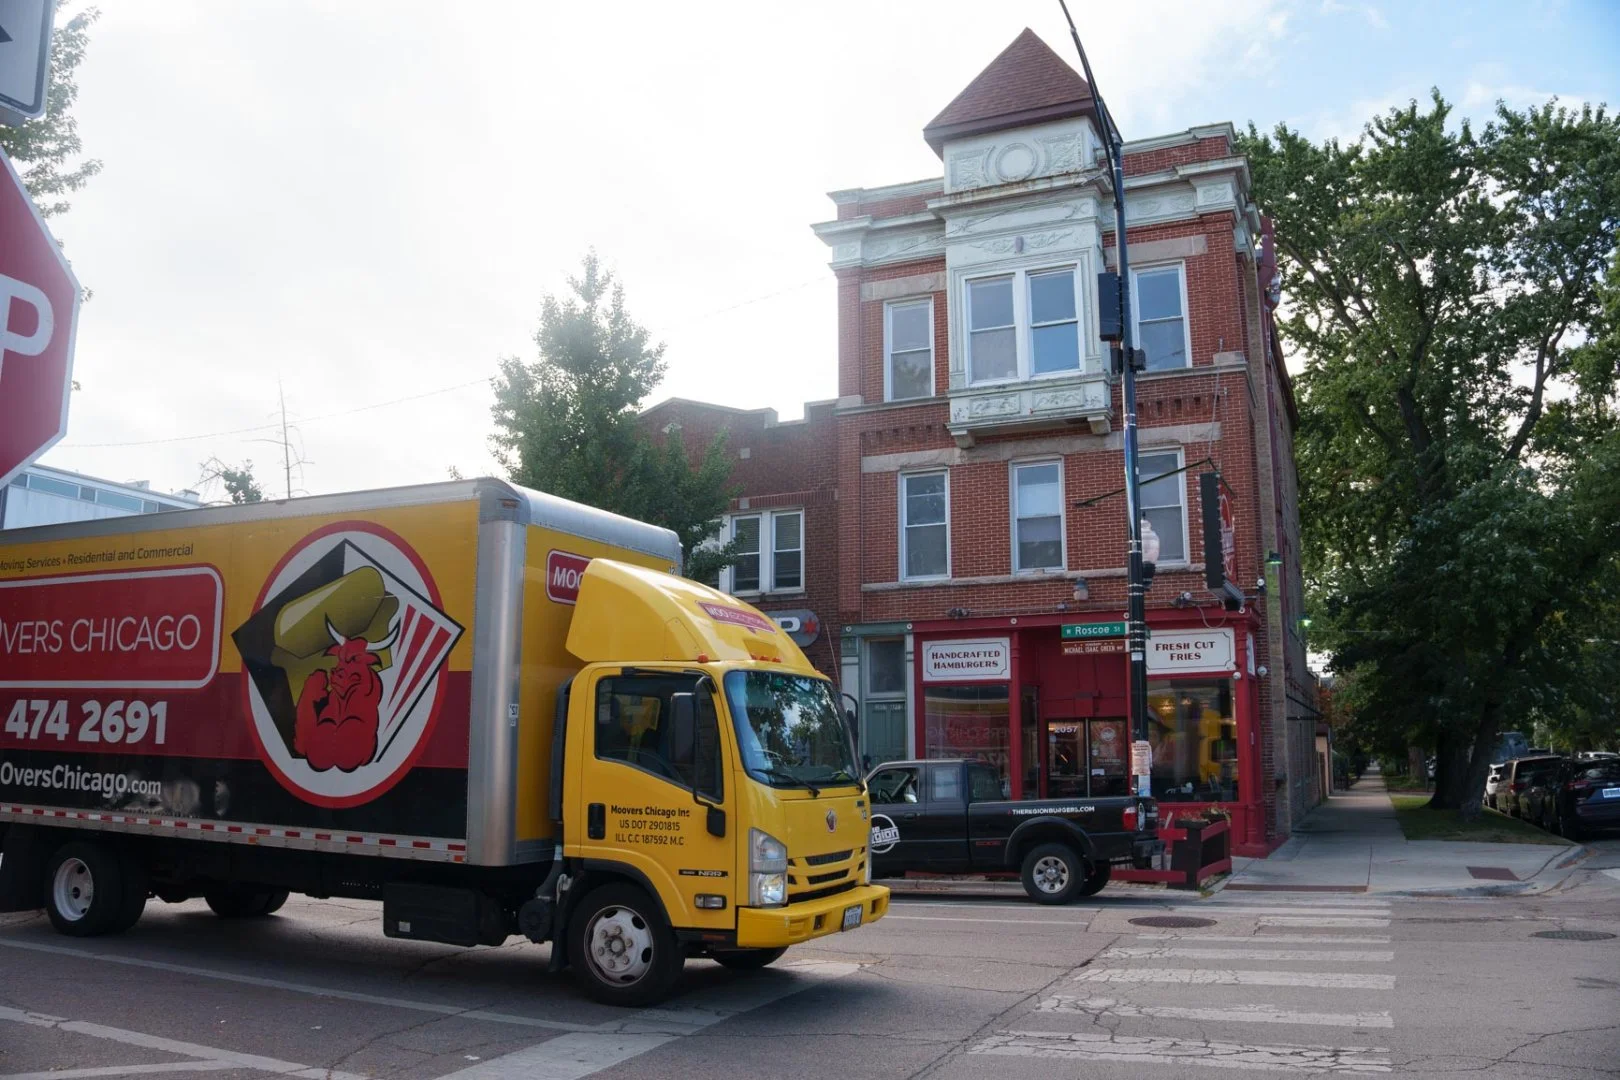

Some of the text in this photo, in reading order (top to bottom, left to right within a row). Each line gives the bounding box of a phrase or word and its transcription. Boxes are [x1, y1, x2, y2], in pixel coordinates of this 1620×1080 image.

[26, 558, 61, 568] Services
[67, 551, 115, 565] Residential
[118, 549, 135, 561] and
[137, 544, 194, 559] Commercial
[0, 614, 201, 654] VERS CHICAGO
[1075, 626, 1110, 635] Roscoe
[1155, 641, 1215, 651] FRESH CUT
[931, 650, 1000, 660] HANDCRAFTED
[1170, 652, 1201, 661] FRIES
[933, 660, 998, 669] HAMBURGERS
[5, 699, 168, 745] 474 2691
[1055, 725, 1078, 733] 2057
[0, 761, 162, 799] OversChicago.com
[611, 804, 643, 815] Moovers
[645, 806, 676, 818] Chicago
[1012, 806, 1095, 815] THEREGIONBURGERS.COM
[620, 820, 680, 831] US DOT 2901815
[615, 833, 626, 843] ILL
[642, 835, 668, 845] 187592
